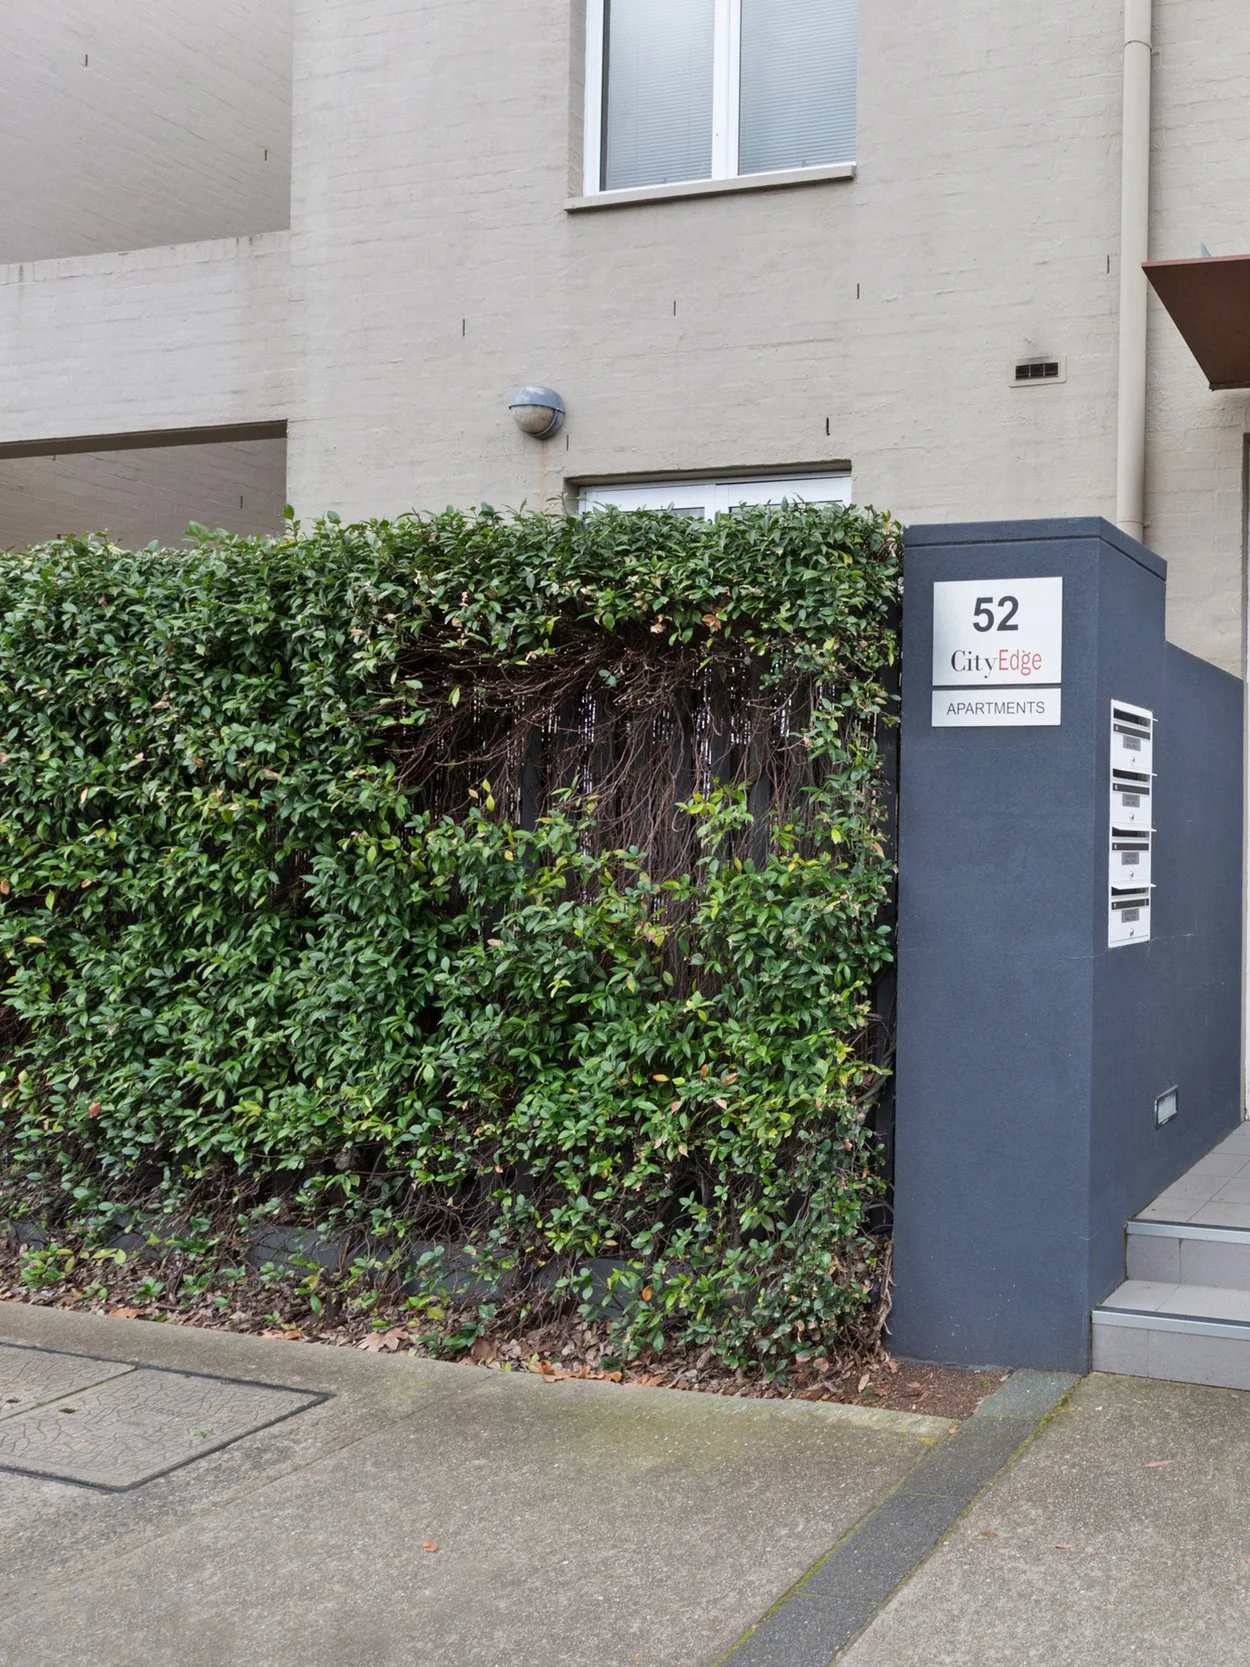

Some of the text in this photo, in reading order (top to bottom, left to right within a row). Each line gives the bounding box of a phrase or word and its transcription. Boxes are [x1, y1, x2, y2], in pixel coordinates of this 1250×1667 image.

[972, 595, 1019, 633] 52
[950, 648, 1042, 679] CityEdge
[946, 701, 1046, 716] APARTMENTS
